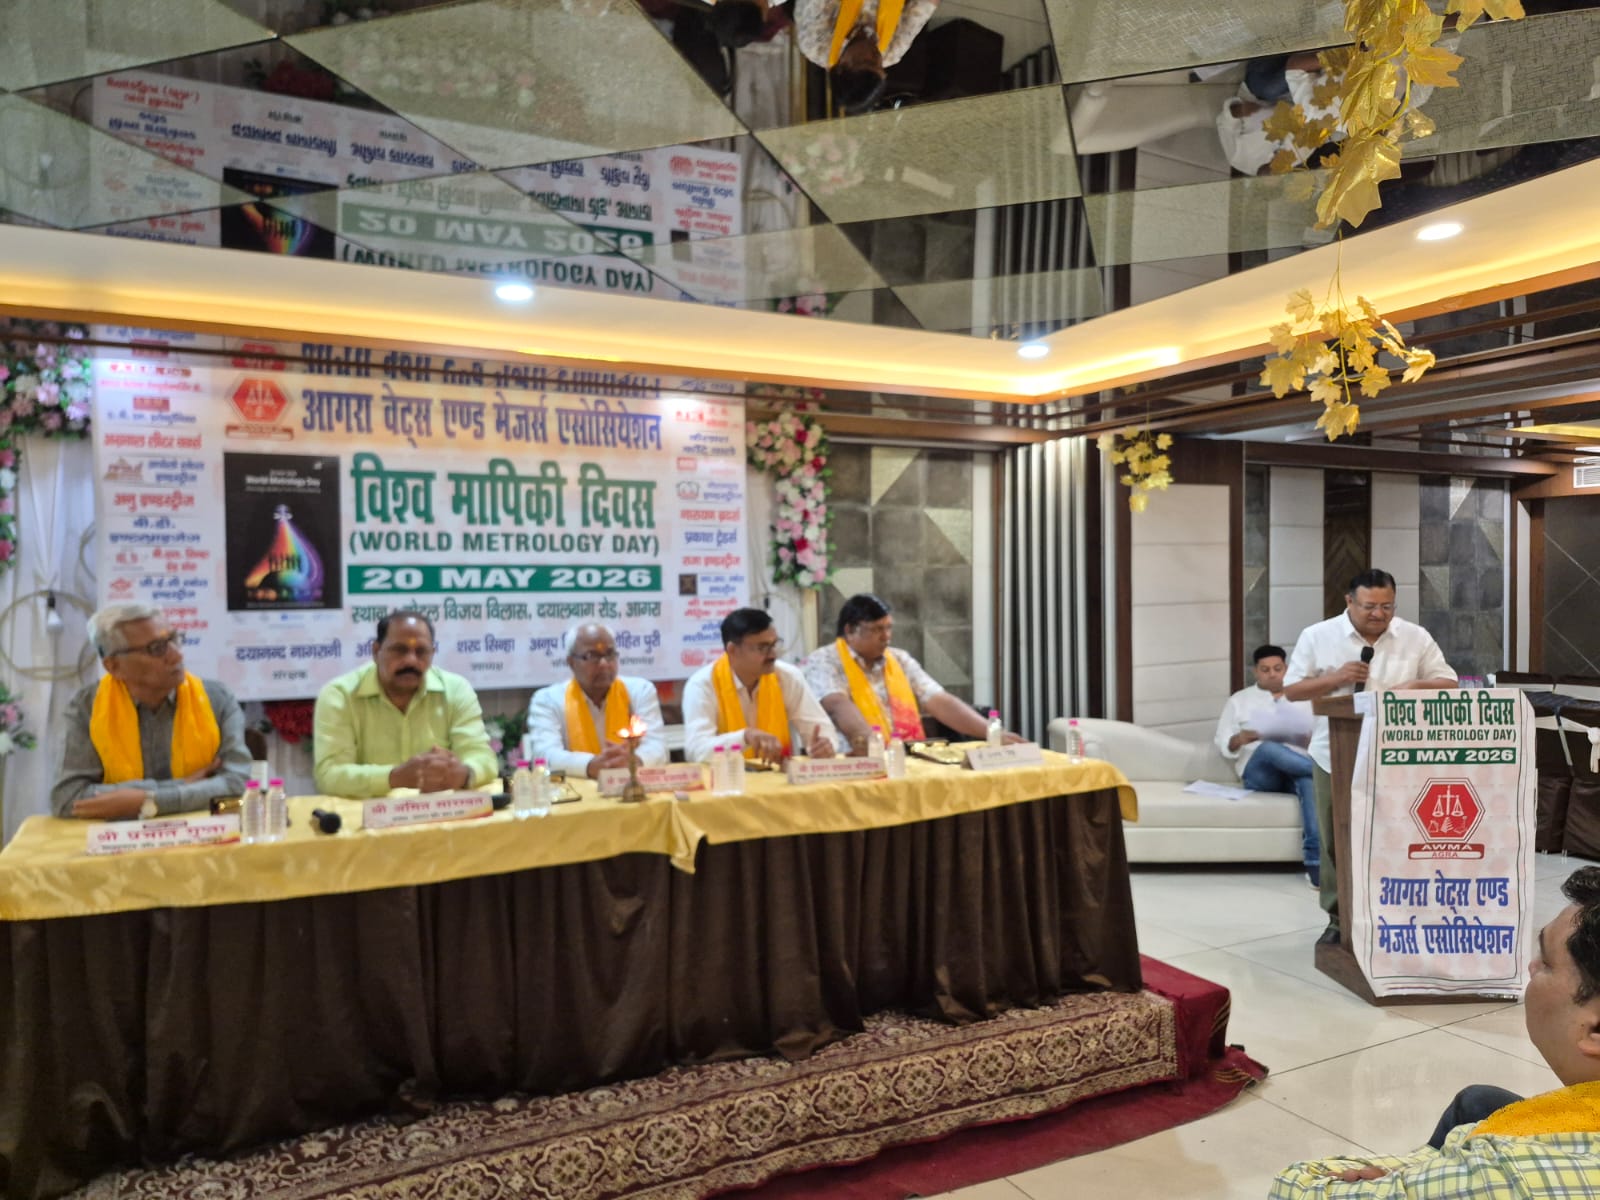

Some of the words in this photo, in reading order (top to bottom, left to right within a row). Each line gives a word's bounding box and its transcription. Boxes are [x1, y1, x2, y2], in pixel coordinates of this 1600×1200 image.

[302, 389, 373, 433] आगरा
[381, 383, 433, 448] वेट्स
[441, 398, 485, 440] एण्ड
[350, 452, 437, 525] विश्व
[448, 458, 568, 528] मापिकी
[578, 462, 657, 529] दिवस
[349, 531, 453, 554] (WORLD
[463, 531, 604, 554] METROLOGY
[612, 533, 660, 557] DAY)
[362, 568, 425, 590] 20
[440, 568, 537, 588] MAY
[550, 567, 653, 588] 2026
[443, 598, 483, 621] विजय
[536, 601, 595, 620] दयालबाग
[625, 601, 662, 618] आगरा
[1382, 691, 1417, 727] विश्व
[1421, 690, 1473, 726] मापिकी
[1478, 690, 1515, 726] दिवस
[1381, 730, 1424, 744] (WORLD
[1426, 729, 1490, 742] METROLOGY
[1492, 729, 1517, 743] DAY)
[1384, 751, 1410, 763] 20
[1416, 750, 1458, 762] MAY
[1464, 750, 1514, 762] 2026
[1421, 843, 1473, 851] AWMA
[1379, 876, 1430, 907] आगरा
[1435, 869, 1470, 914] वेट्स
[1476, 876, 1510, 907] एण्ड
[1377, 915, 1421, 954] मेजर्स
[1422, 915, 1515, 955] एसोसियेशन
